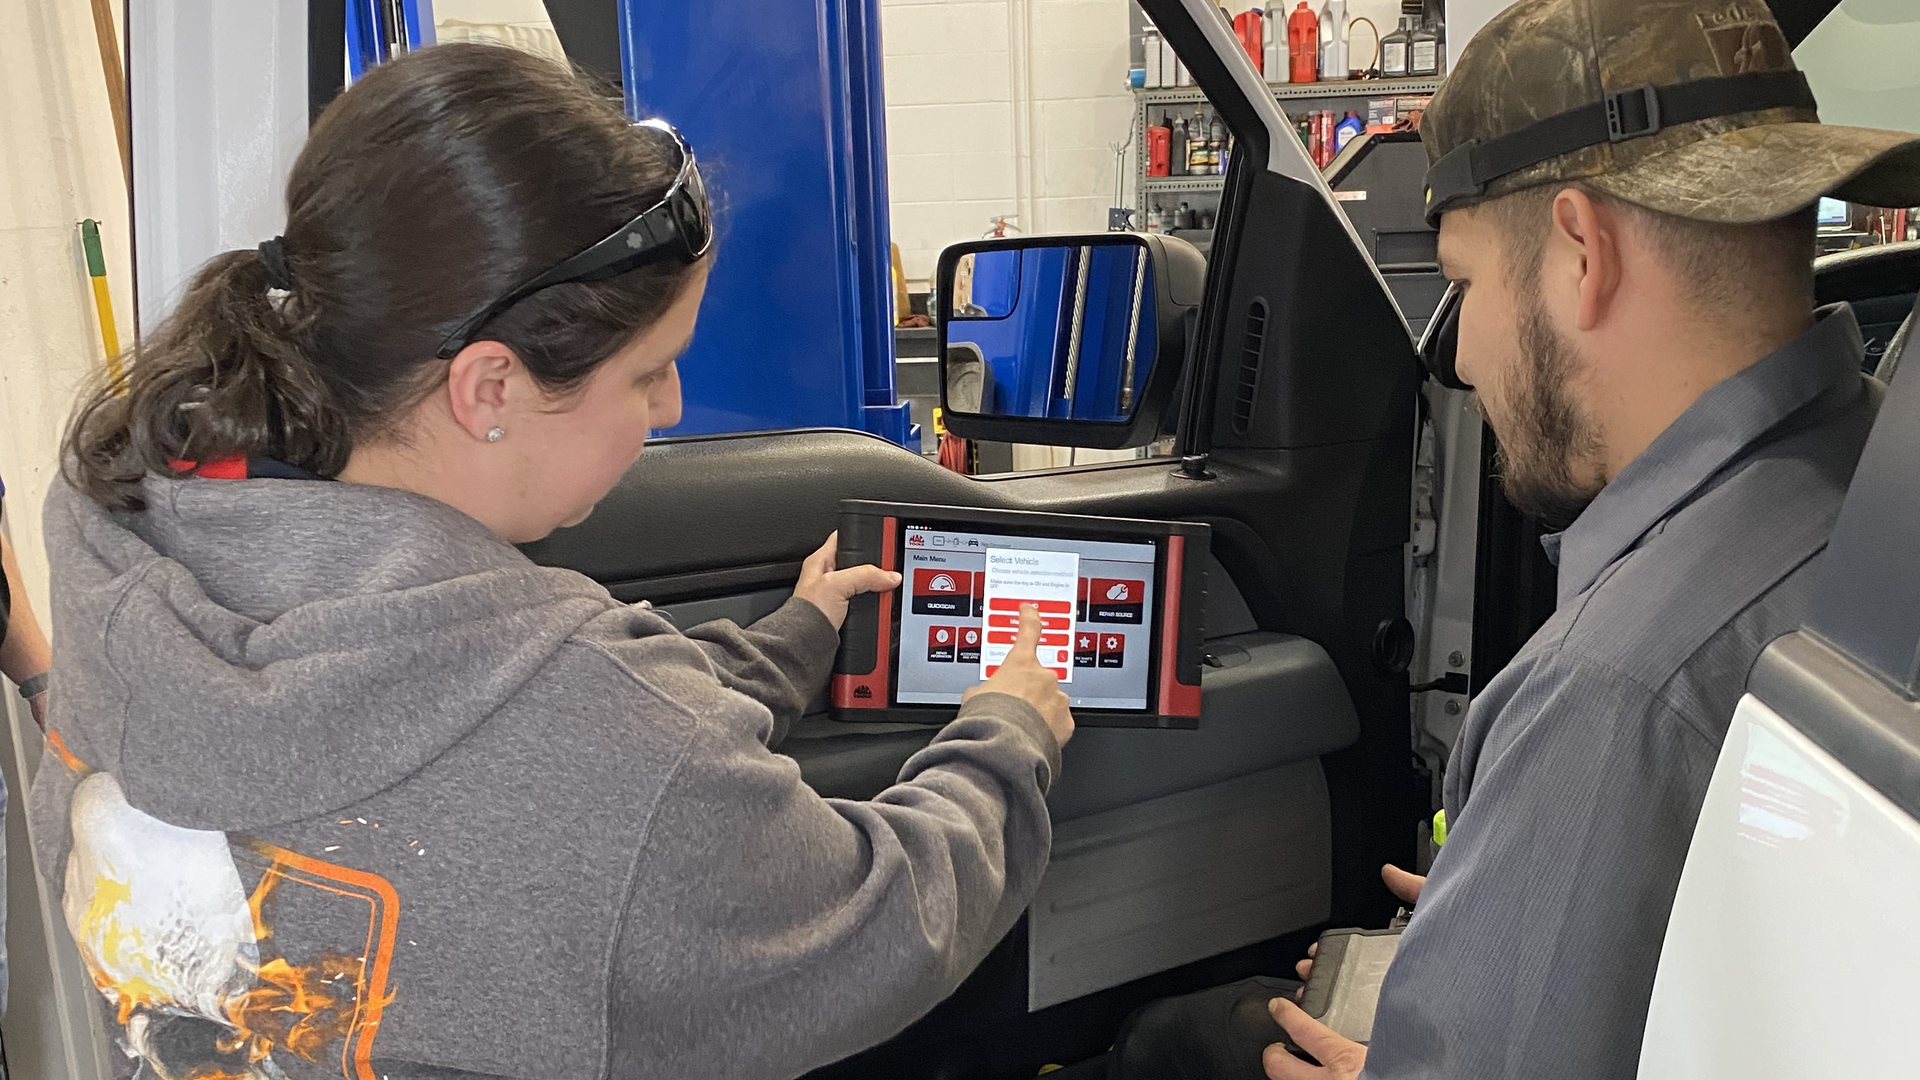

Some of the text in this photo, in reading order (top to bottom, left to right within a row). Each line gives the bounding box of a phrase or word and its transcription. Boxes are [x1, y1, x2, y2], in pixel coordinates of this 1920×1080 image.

[929, 555, 946, 563] Menu
[990, 555, 1039, 566] Select Vehicle
